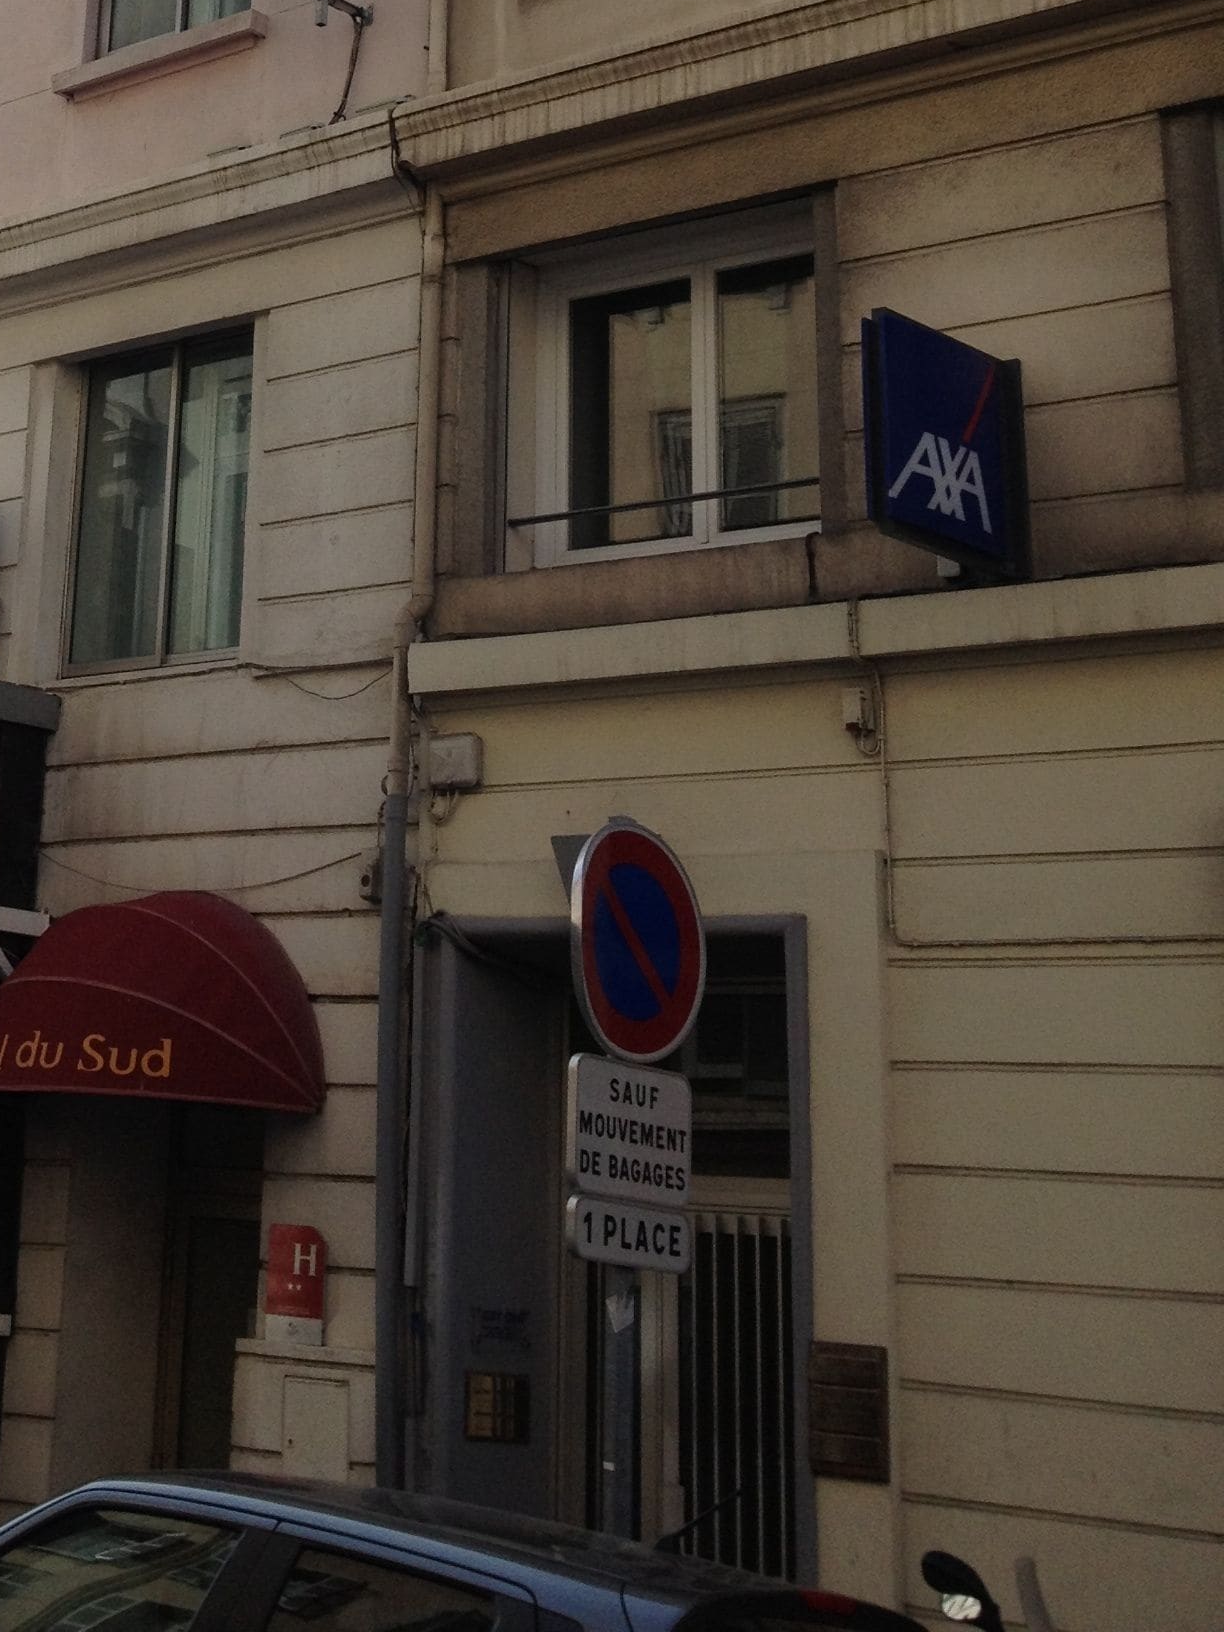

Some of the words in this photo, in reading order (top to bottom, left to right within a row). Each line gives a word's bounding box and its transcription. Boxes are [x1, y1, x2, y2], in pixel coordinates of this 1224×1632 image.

[888, 431, 993, 535] AXA
[15, 1030, 64, 1069] du
[77, 1034, 172, 1078] Sud
[610, 1078, 659, 1109] SAUF
[579, 1110, 686, 1153] MOUVEMENT
[579, 1149, 601, 1176] DE
[608, 1154, 686, 1191] BAGAGES
[583, 1211, 592, 1243] 1
[603, 1214, 681, 1257] PLACE
[292, 1242, 318, 1277] H
